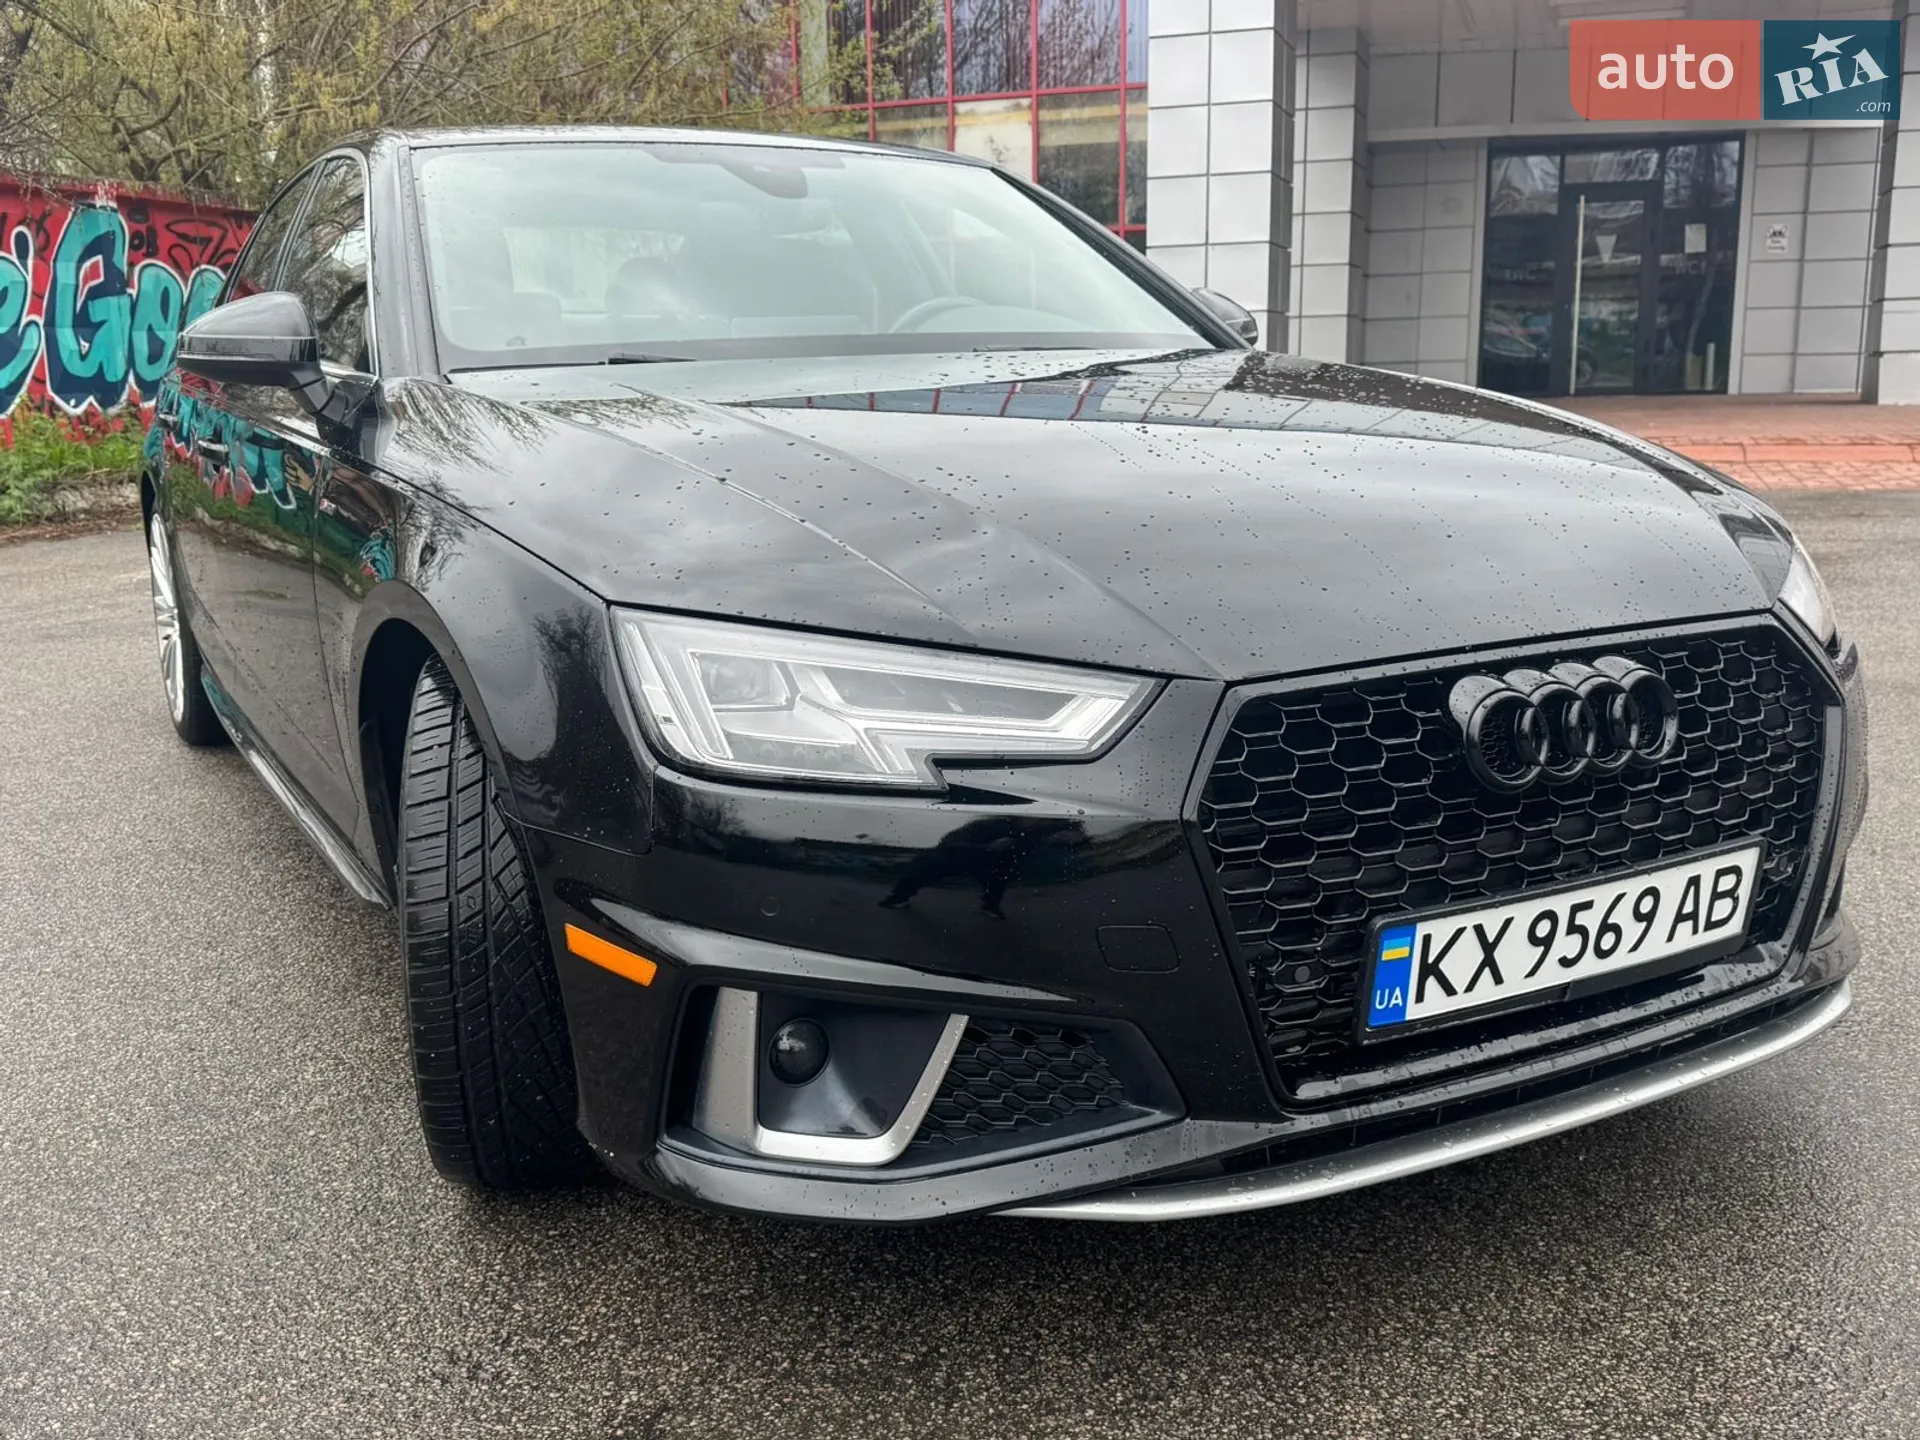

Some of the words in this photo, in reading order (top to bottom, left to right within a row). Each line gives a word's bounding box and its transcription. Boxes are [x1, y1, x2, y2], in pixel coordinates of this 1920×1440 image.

[1414, 916, 1515, 1005] KX
[1524, 885, 1662, 979] 9569
[1666, 864, 1743, 944] AB
[1375, 987, 1403, 1010] UA
